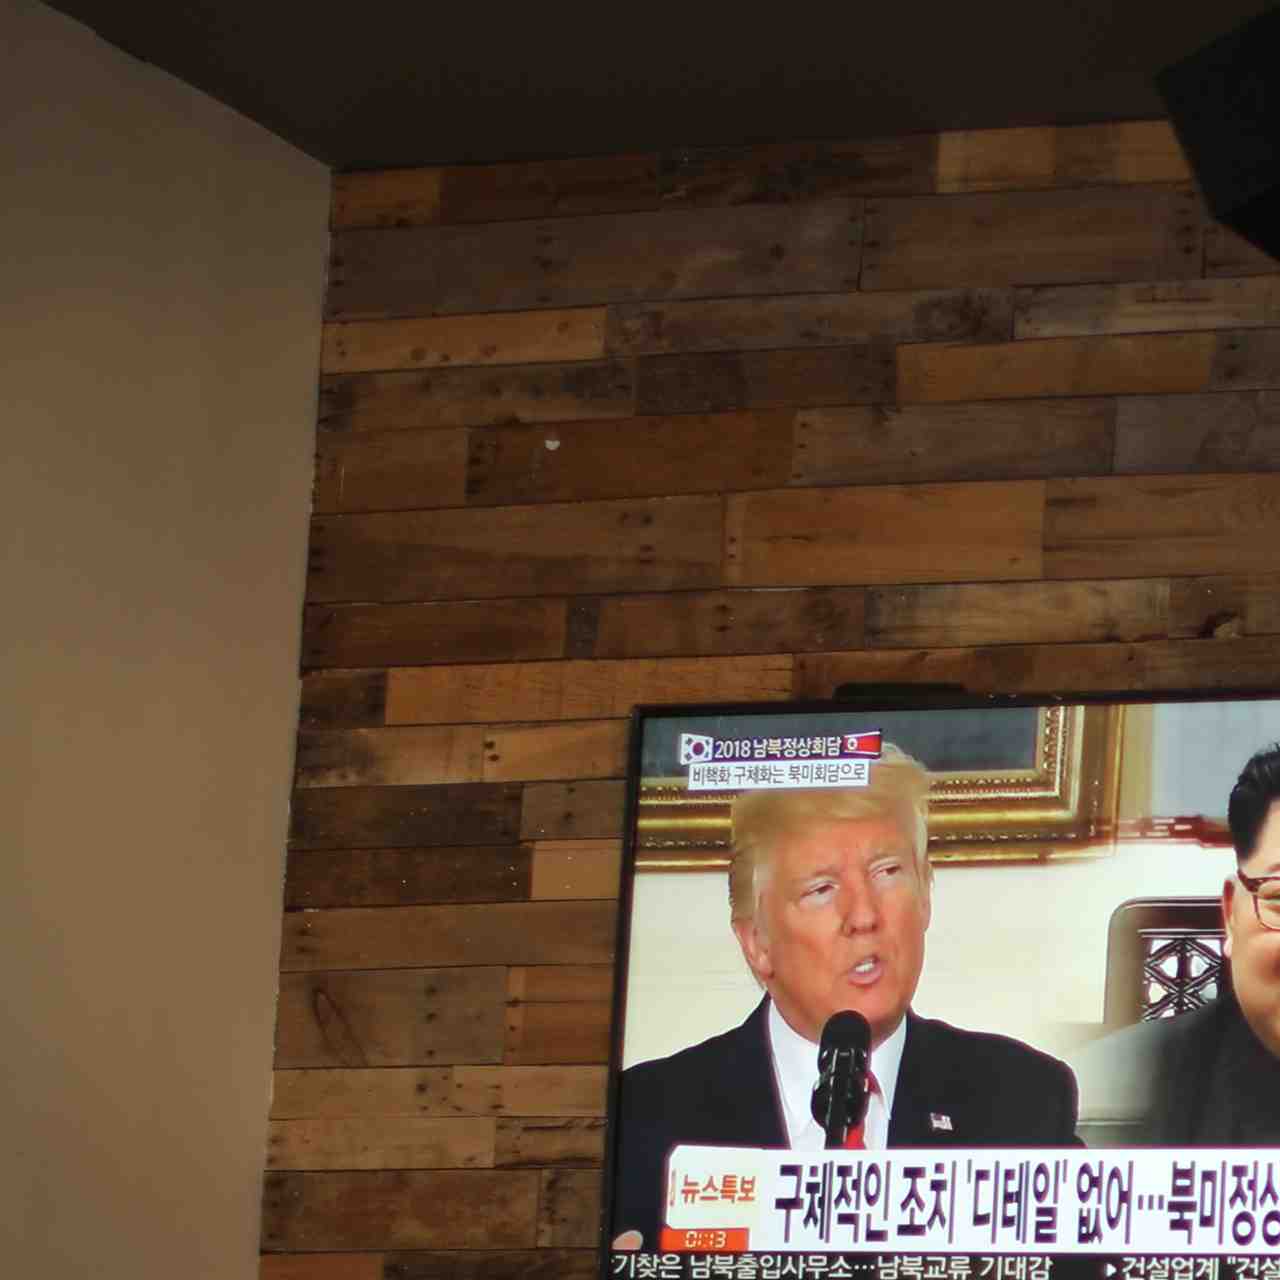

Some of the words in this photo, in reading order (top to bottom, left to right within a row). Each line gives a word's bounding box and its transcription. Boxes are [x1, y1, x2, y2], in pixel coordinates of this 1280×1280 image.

[714, 740, 751, 759] 2018
[753, 735, 842, 758] 남북정상회담
[692, 766, 731, 785] 비핵화
[734, 765, 785, 785] 구체화는
[788, 763, 866, 783] 북미회담으로
[681, 1174, 757, 1204] 뉴스특보
[774, 1160, 892, 1244] 구체적인
[897, 1160, 957, 1244] 조치
[966, 1159, 1068, 1244] '디테일'
[611, 1253, 683, 1279] 기찾은
[980, 1256, 1053, 1280] 기대감
